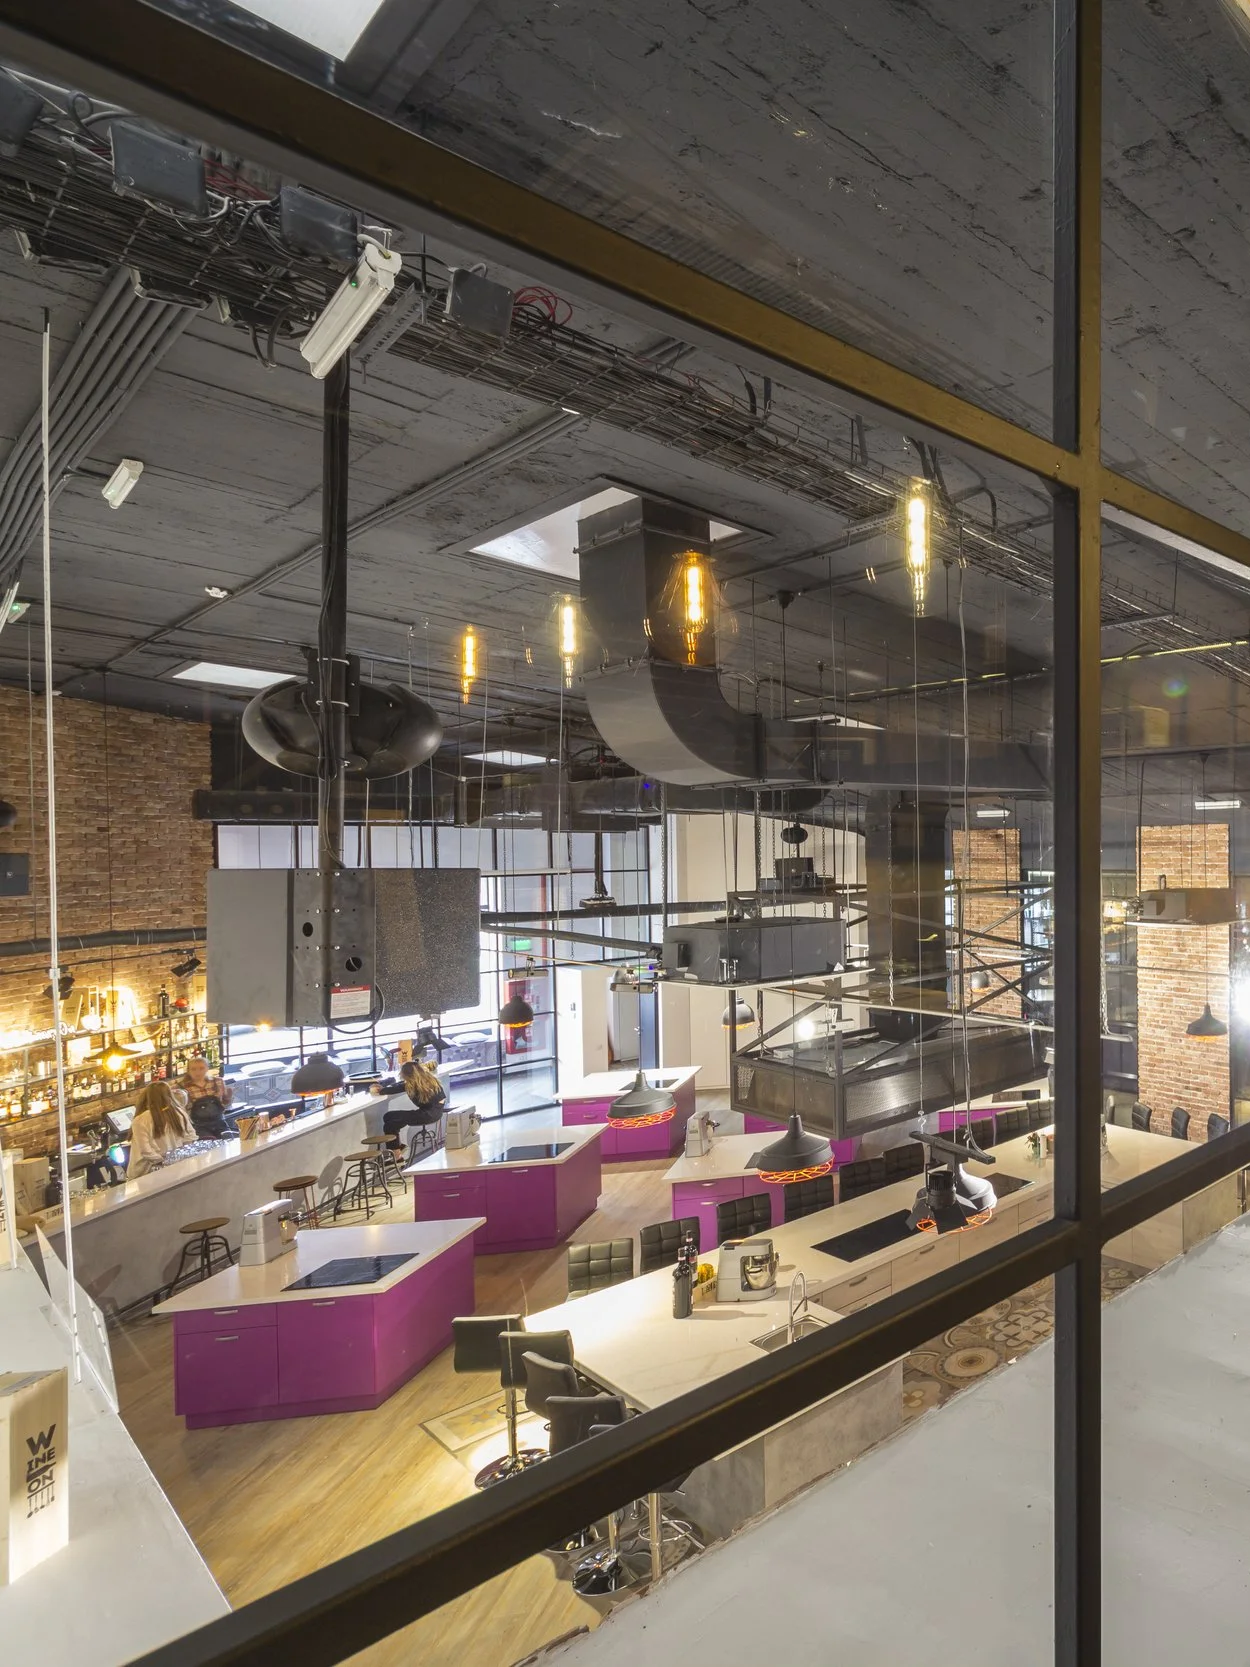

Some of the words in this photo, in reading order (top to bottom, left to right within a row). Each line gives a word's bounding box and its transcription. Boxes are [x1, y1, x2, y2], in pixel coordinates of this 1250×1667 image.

[26, 1423, 57, 1456] W
[27, 1446, 56, 1474] INE
[27, 1468, 54, 1493] ON
